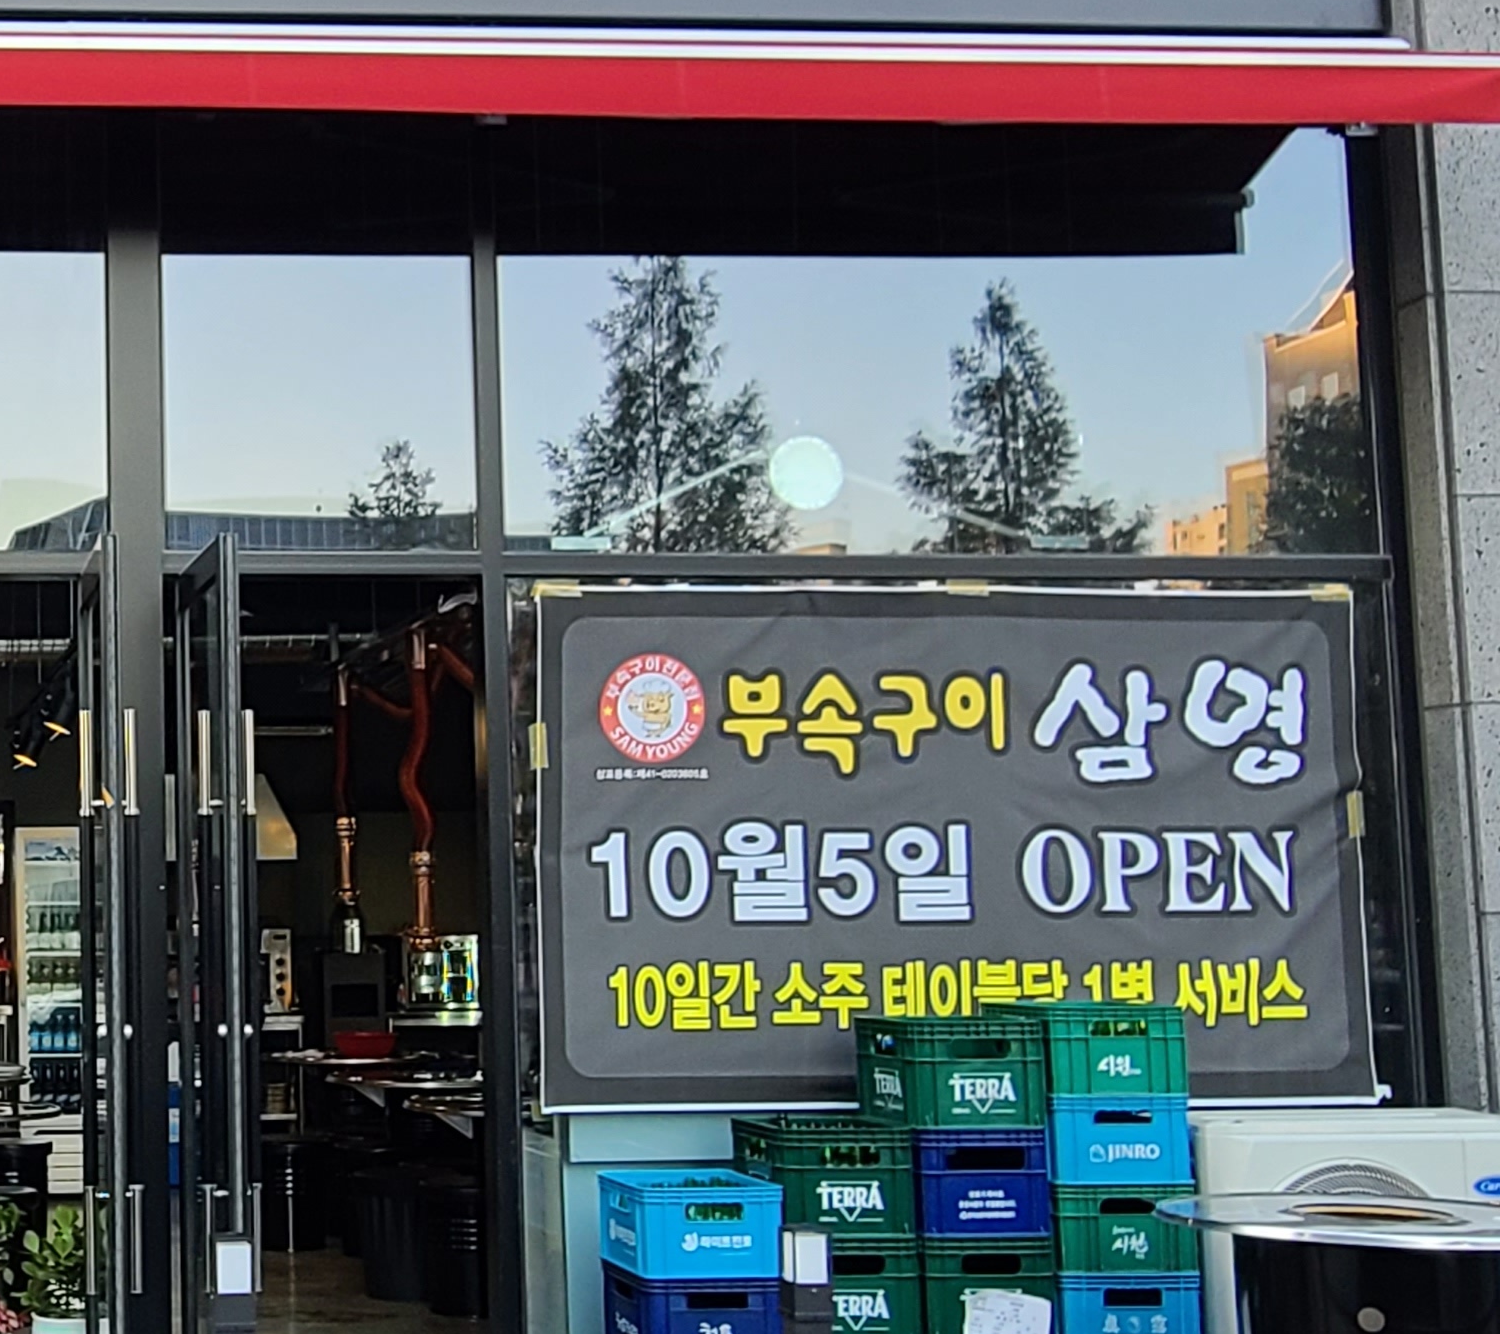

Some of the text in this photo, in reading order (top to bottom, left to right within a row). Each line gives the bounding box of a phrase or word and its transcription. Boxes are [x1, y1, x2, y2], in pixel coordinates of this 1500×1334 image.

[723, 659, 1304, 784] 부속구이 삼영
[610, 722, 698, 759] SAM YOUNG
[591, 821, 1294, 922] 10월5일 OPEN
[609, 960, 761, 1030] 10일간
[772, 962, 869, 1030] 소주
[1175, 958, 1308, 1027] 서비스
[948, 1072, 1017, 1102] TERRA
[1107, 1143, 1161, 1163] JINRO
[816, 1180, 885, 1210] TERRA
[832, 1288, 890, 1319] ERRA
